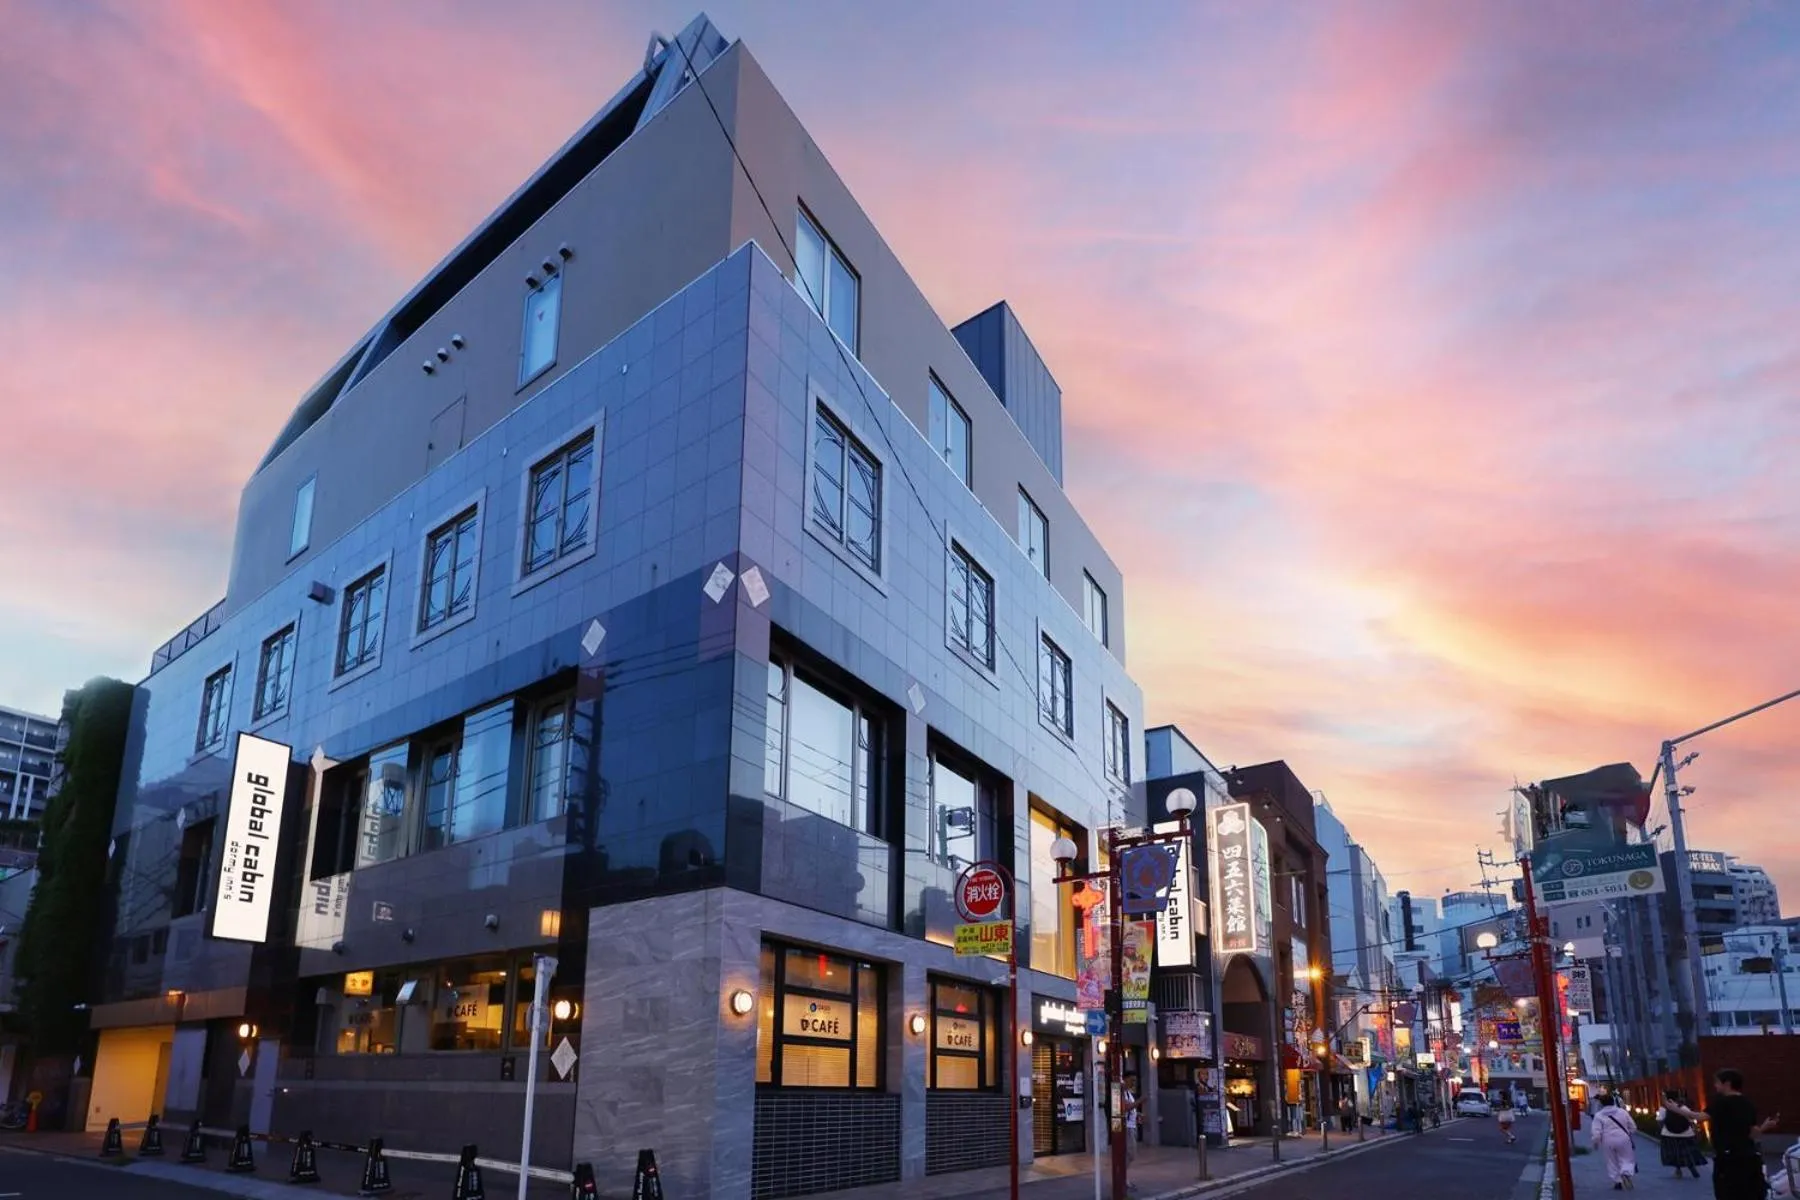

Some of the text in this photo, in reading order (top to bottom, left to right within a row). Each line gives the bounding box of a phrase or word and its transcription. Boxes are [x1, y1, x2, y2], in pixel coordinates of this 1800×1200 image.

[238, 772, 275, 903] global cabin
[1586, 850, 1649, 866] TOKUNAGA
[966, 883, 1001, 903] 消火栓
[1168, 897, 1184, 940] cabin
[980, 923, 1009, 942] 山東
[454, 1001, 478, 1017] CAFÉ
[811, 1017, 840, 1034] CAFÉ
[953, 1033, 973, 1047] CAFÉ
